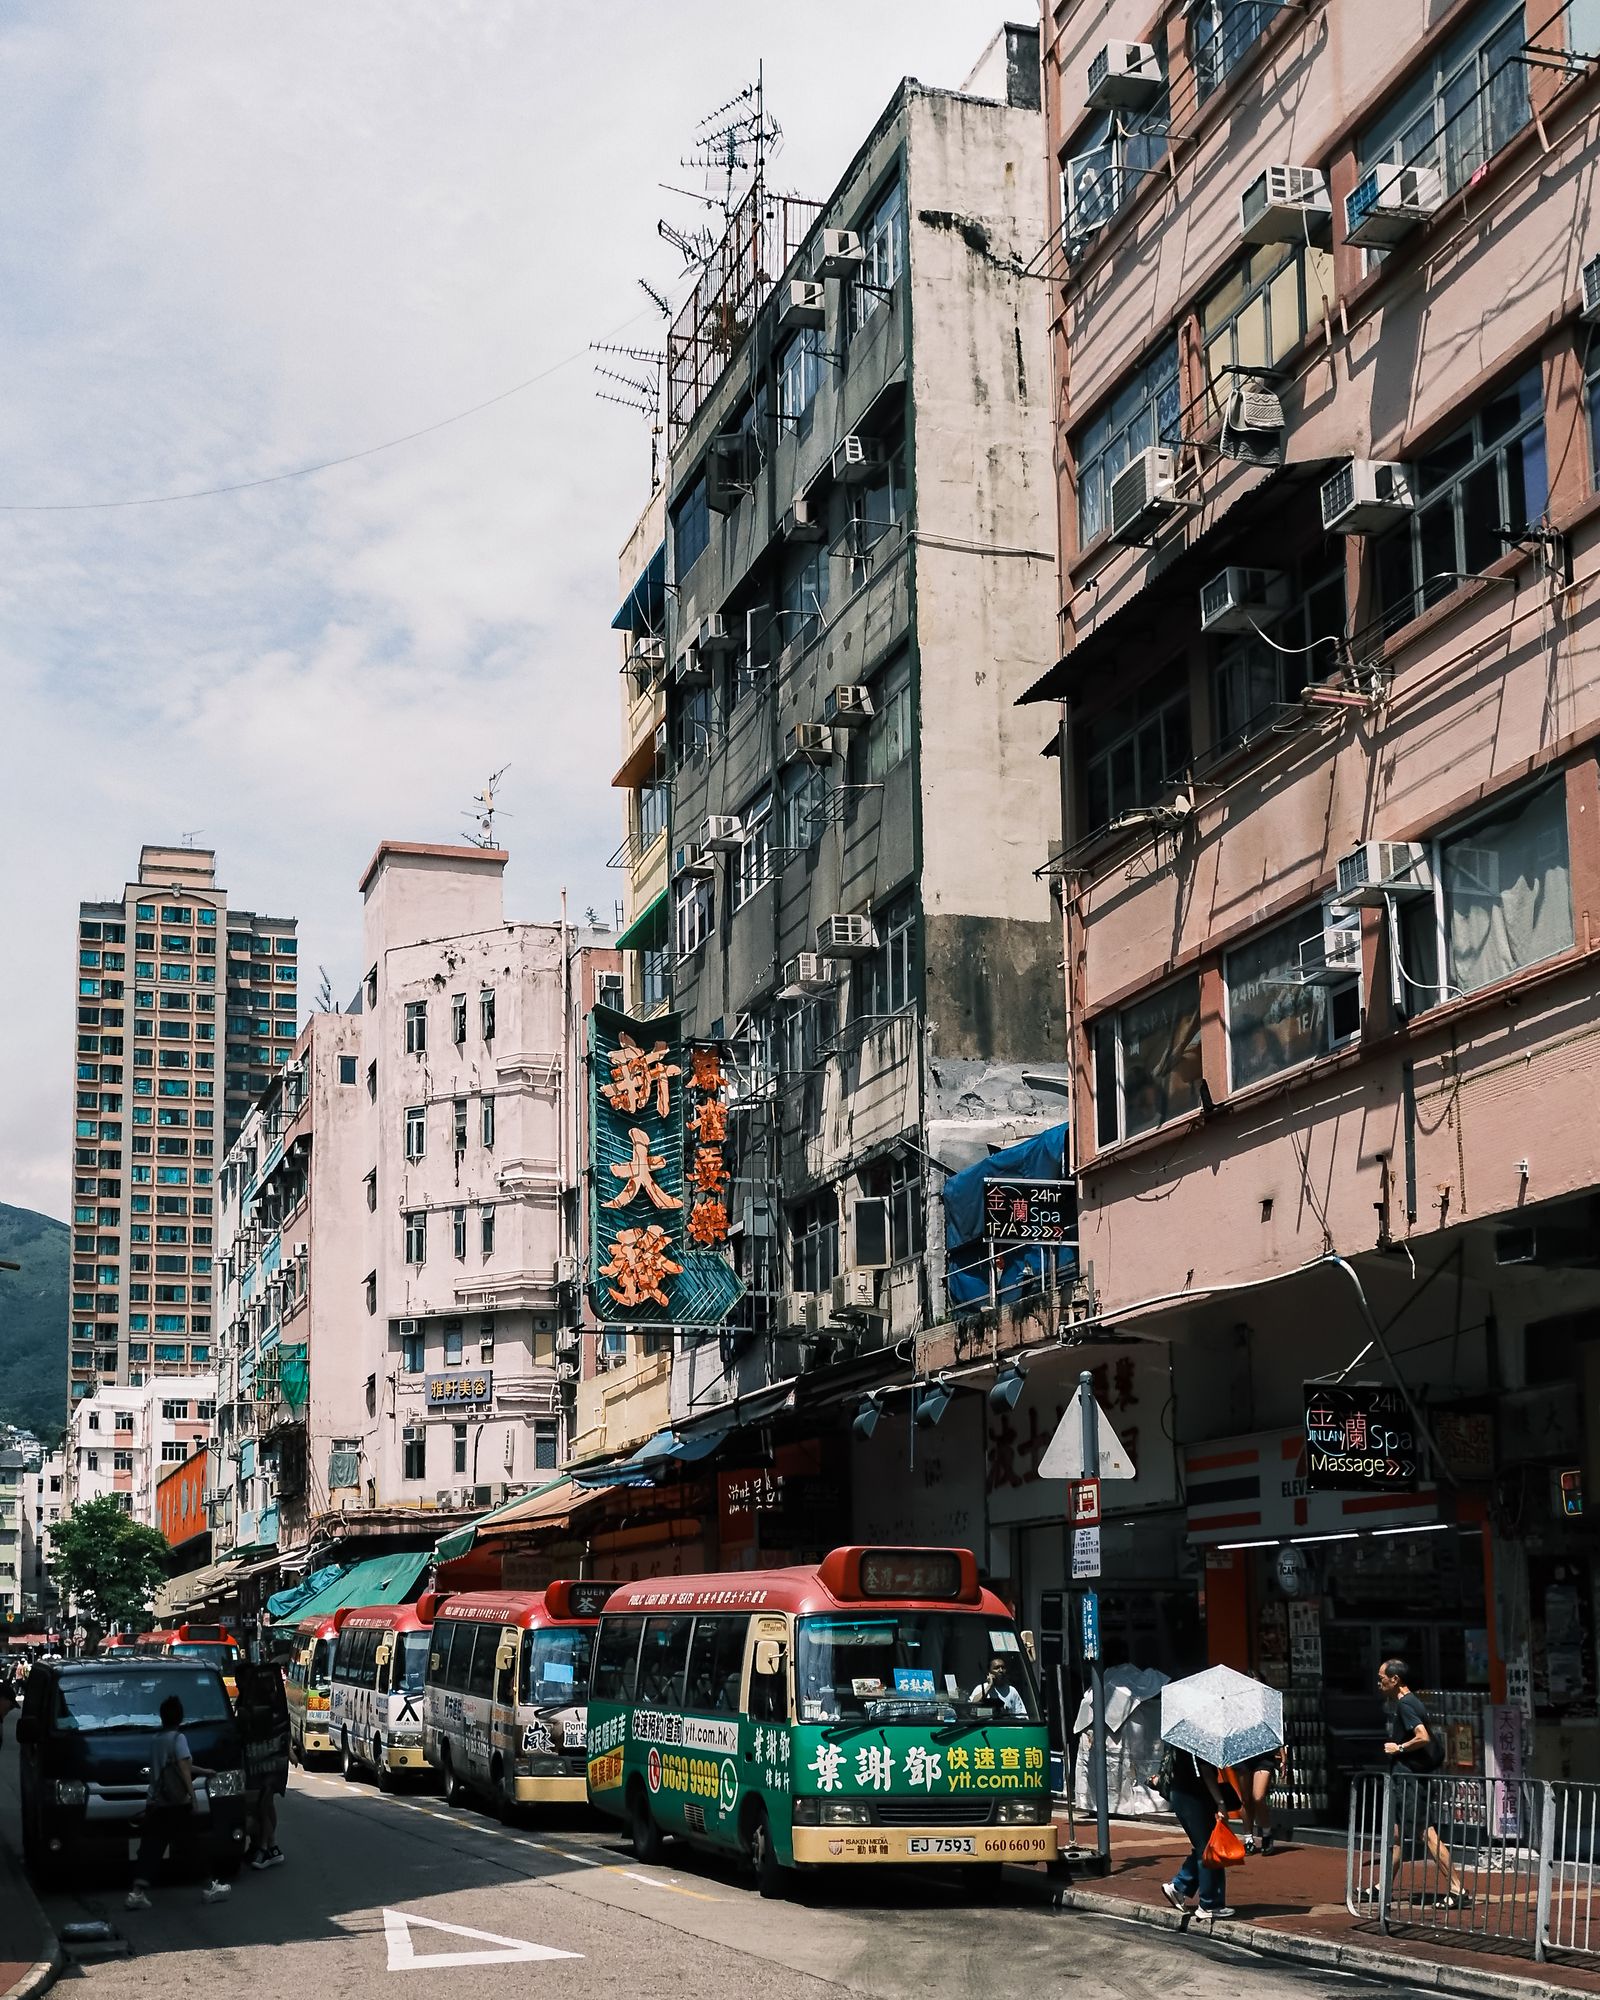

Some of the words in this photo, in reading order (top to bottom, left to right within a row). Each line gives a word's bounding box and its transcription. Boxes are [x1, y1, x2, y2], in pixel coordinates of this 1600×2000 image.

[598, 1031, 684, 1307] 新大發
[1030, 1189, 1062, 1203] 24hr
[1030, 1207, 1061, 1226] Spa
[986, 1222, 1018, 1238] 1F/A
[431, 1377, 486, 1399] 雅軒美容
[1370, 1424, 1413, 1457] Spa
[1311, 1454, 1385, 1477] Massage
[575, 1588, 606, 1597] TSUEN
[685, 1722, 728, 1747] ytt.com.hk
[753, 1727, 790, 1768] 葉謝鄧
[947, 1747, 1043, 1770] 快速查詢
[662, 1753, 688, 1792] 6639
[690, 1758, 719, 1799] 9999
[808, 1743, 942, 1793] 葉謝鄧
[948, 1771, 1043, 1792] ytt.com.hk
[869, 1838, 888, 1846] MEDIA
[911, 1840, 930, 1852] EJ
[936, 1840, 972, 1852] 7593
[985, 1839, 1006, 1851] 660
[1009, 1839, 1030, 1851] 660
[1032, 1839, 1046, 1851] 90
